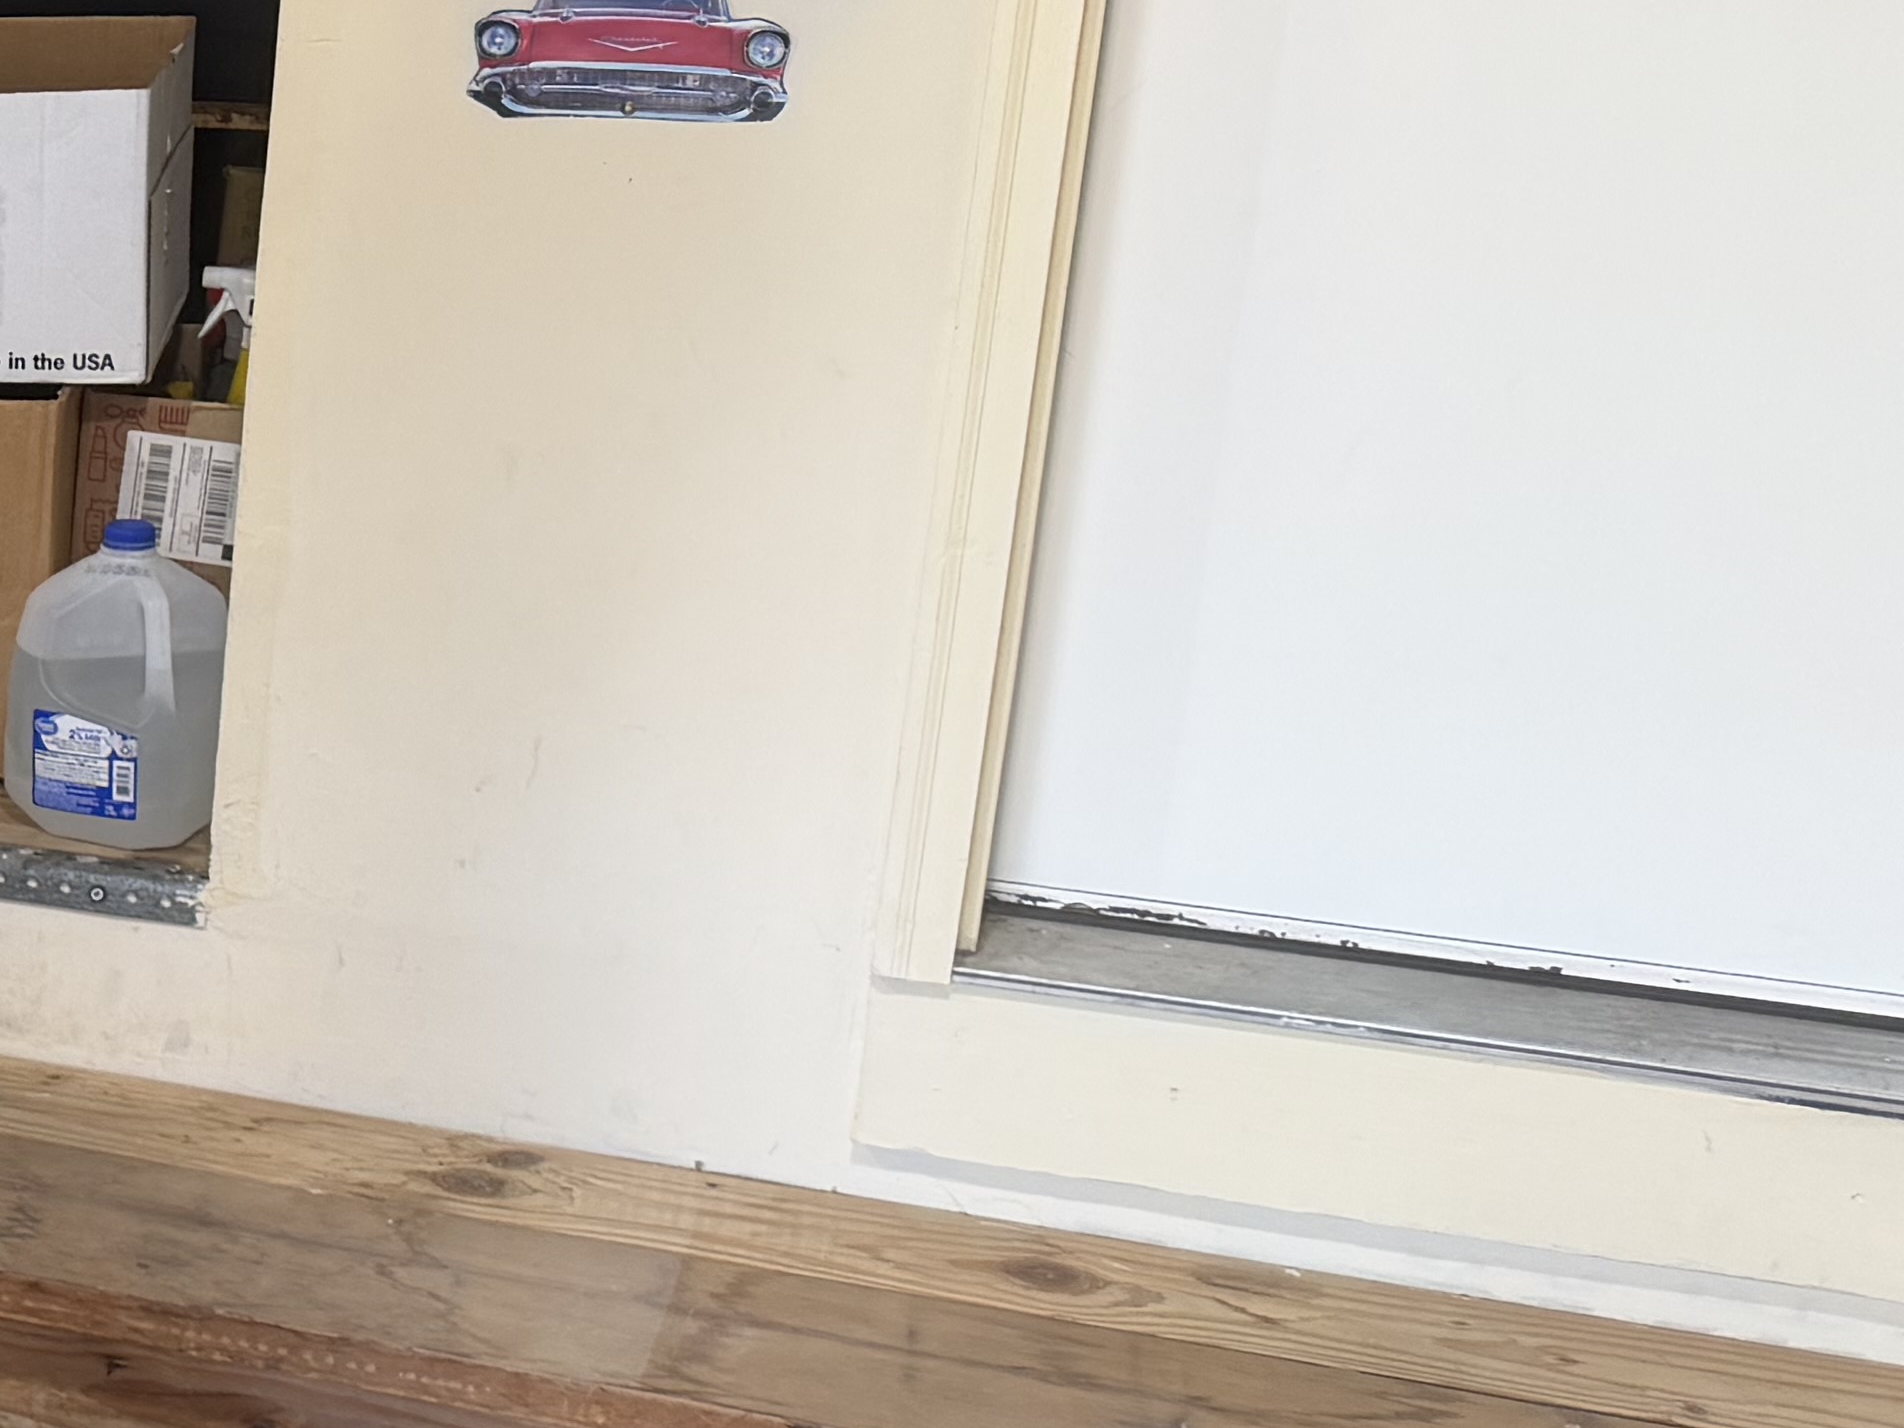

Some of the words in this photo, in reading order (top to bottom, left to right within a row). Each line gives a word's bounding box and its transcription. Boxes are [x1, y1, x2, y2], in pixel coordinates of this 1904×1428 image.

[8, 352, 26, 370] in
[33, 352, 65, 370] the
[72, 353, 115, 371] USA
